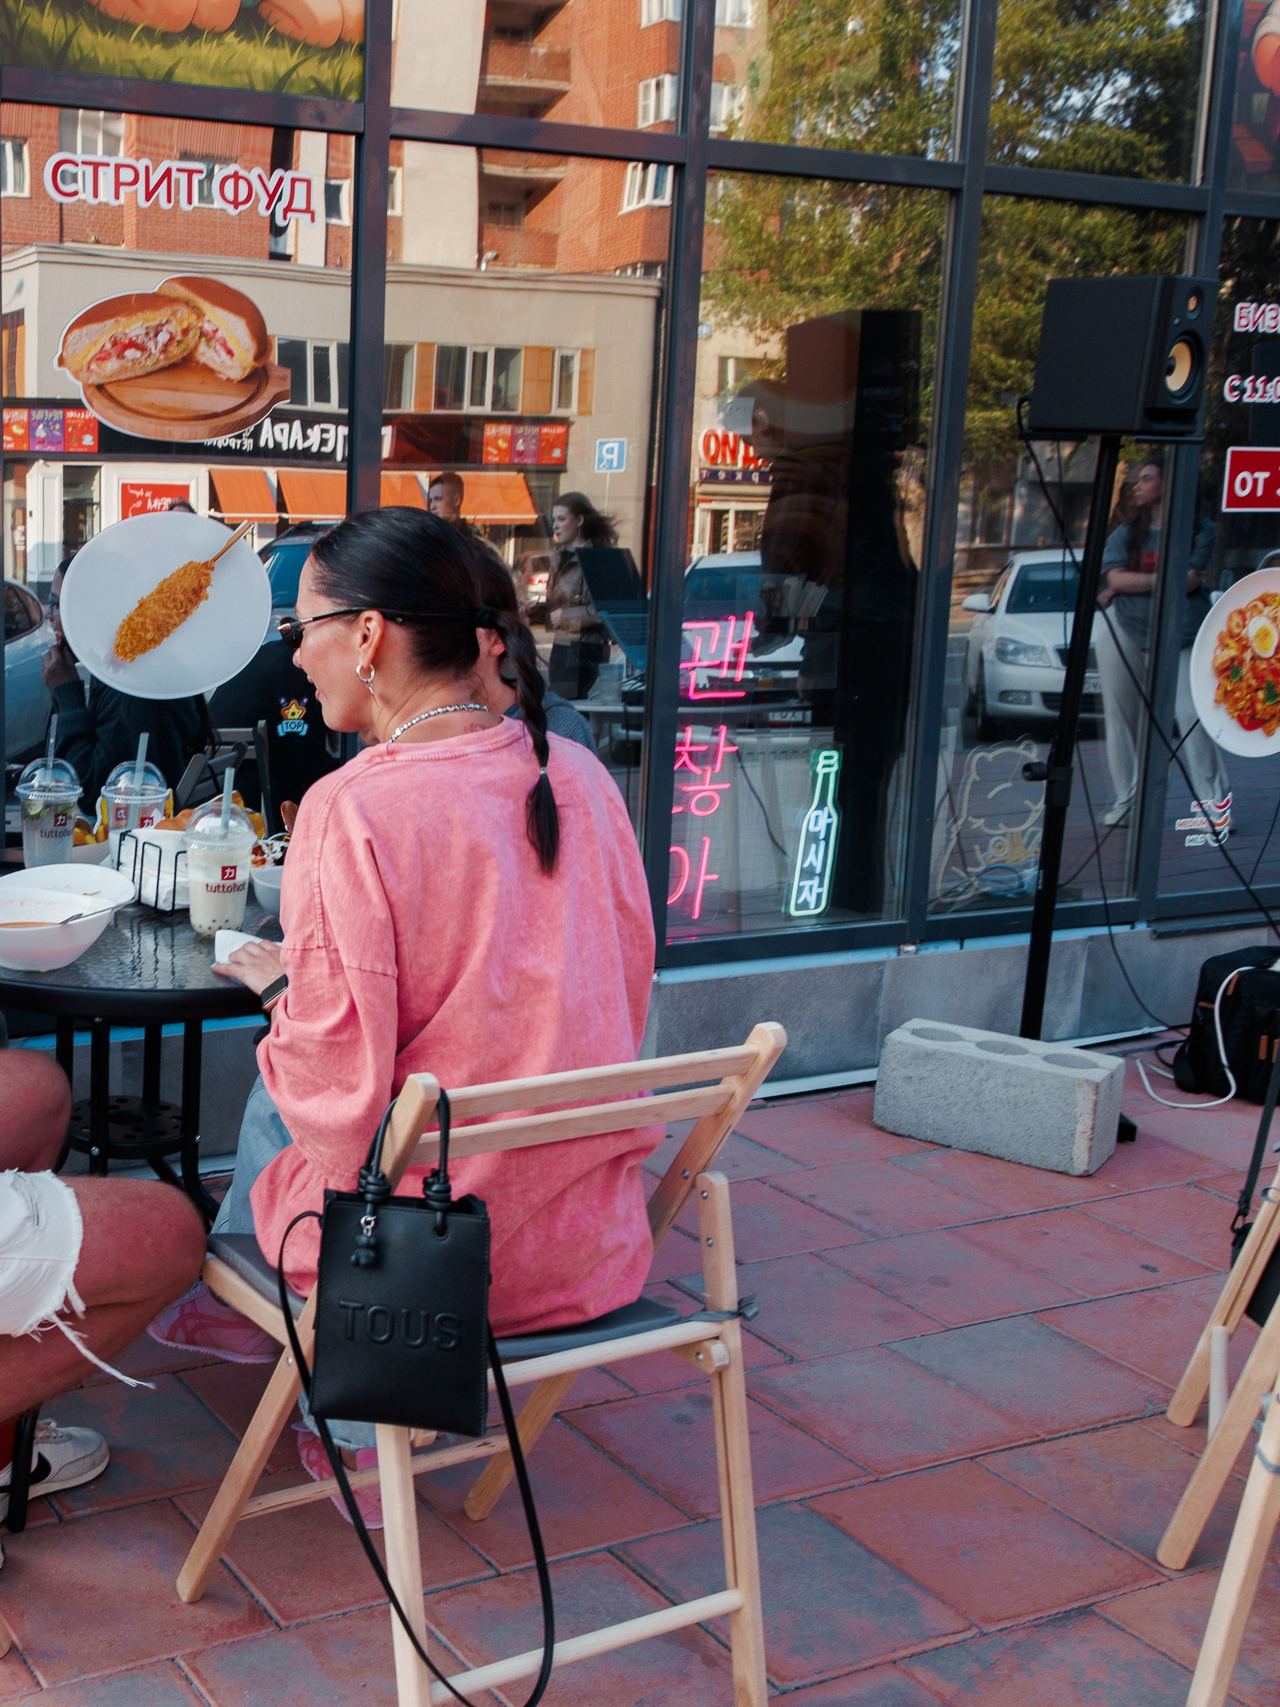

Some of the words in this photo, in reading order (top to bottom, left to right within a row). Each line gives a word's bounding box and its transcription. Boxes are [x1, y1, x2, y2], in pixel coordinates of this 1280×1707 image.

[50, 159, 204, 206] СТРИТ
[219, 168, 316, 223] ФУД
[1234, 471, 1270, 498] ОТ
[283, 720, 303, 732] TOP
[796, 806, 833, 910] 마시자
[339, 1299, 463, 1351] TOUS
